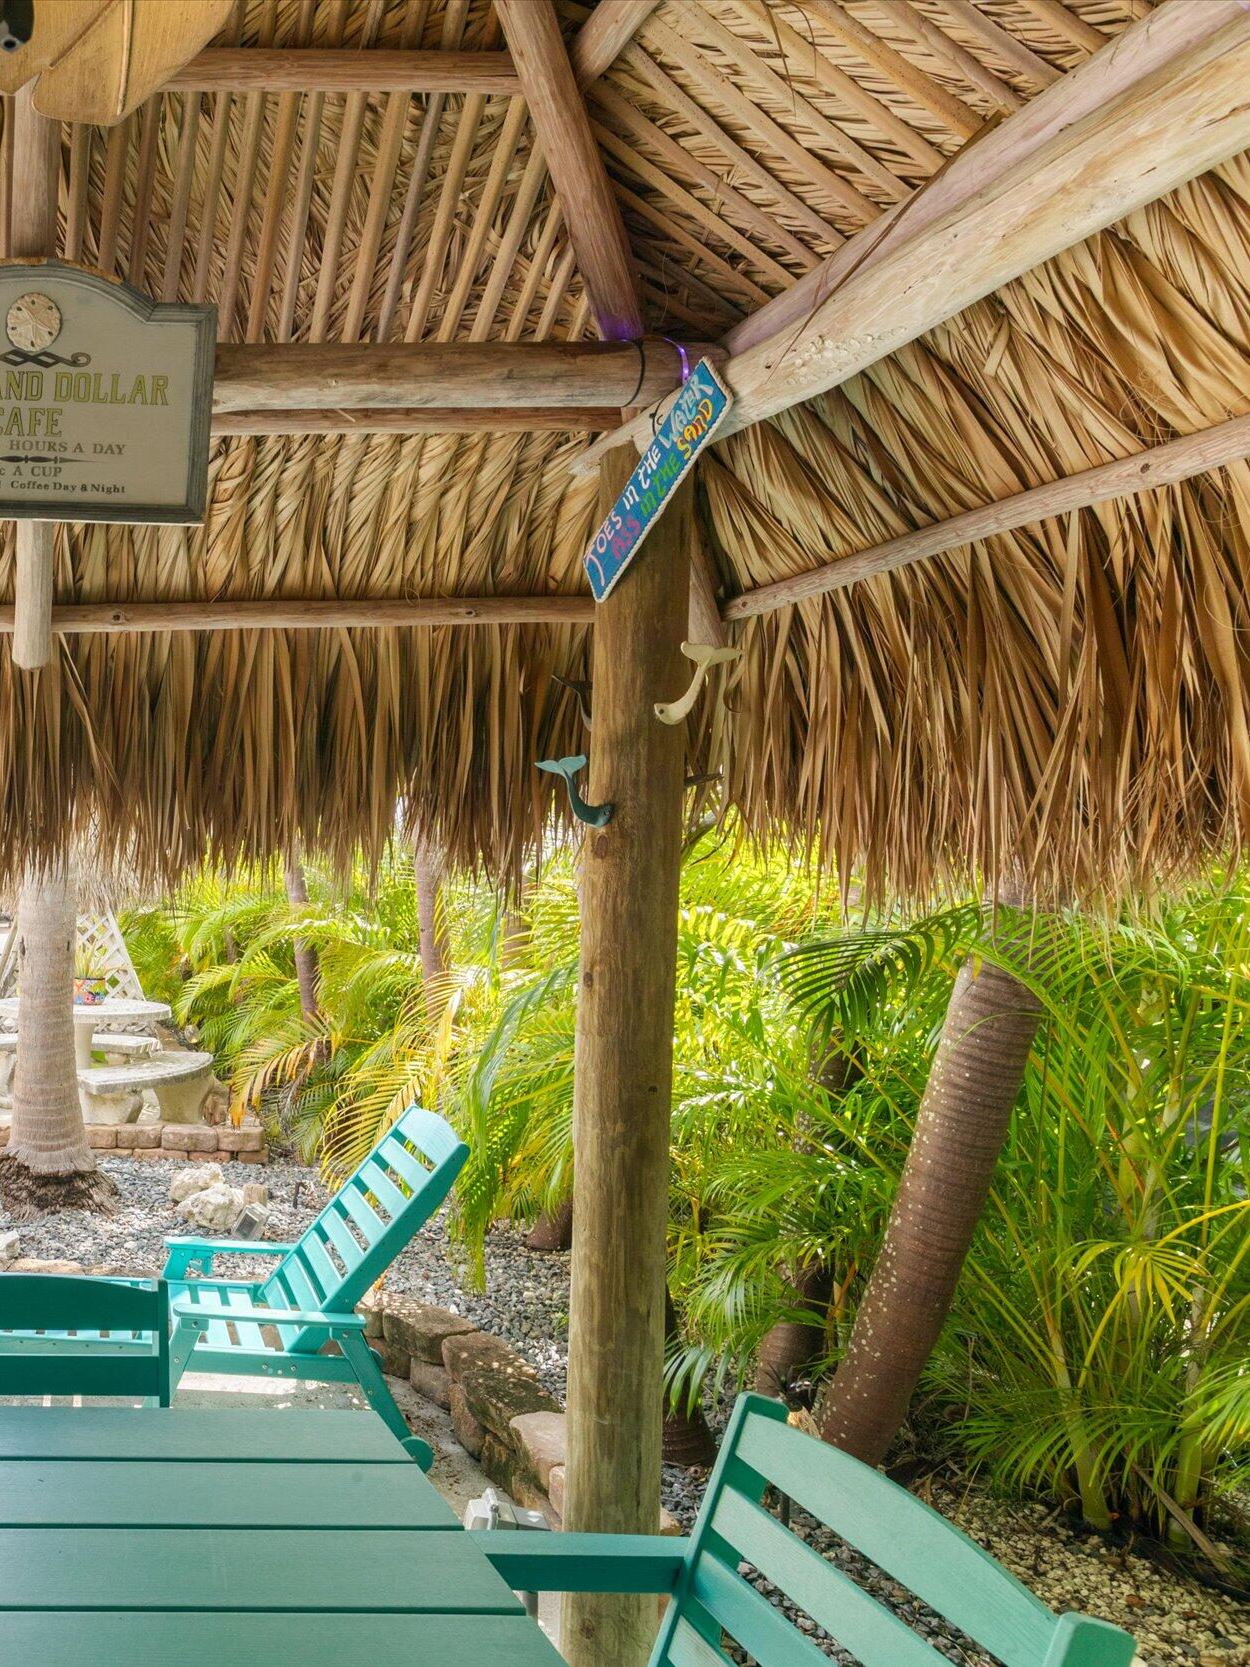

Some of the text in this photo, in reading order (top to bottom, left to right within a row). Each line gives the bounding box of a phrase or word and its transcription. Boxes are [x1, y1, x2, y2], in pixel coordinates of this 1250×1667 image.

[54, 371, 169, 406] DOLLAR
[9, 440, 68, 453] HOURS
[73, 442, 85, 454] A
[93, 442, 126, 456] DAY
[12, 466, 23, 477] A
[31, 466, 62, 477] CUP
[10, 480, 50, 490] Coffee
[53, 481, 77, 492] Day
[80, 483, 88, 492] &
[91, 483, 125, 495] Night
[585, 511, 622, 586] TOES
[612, 514, 640, 560] ASS
